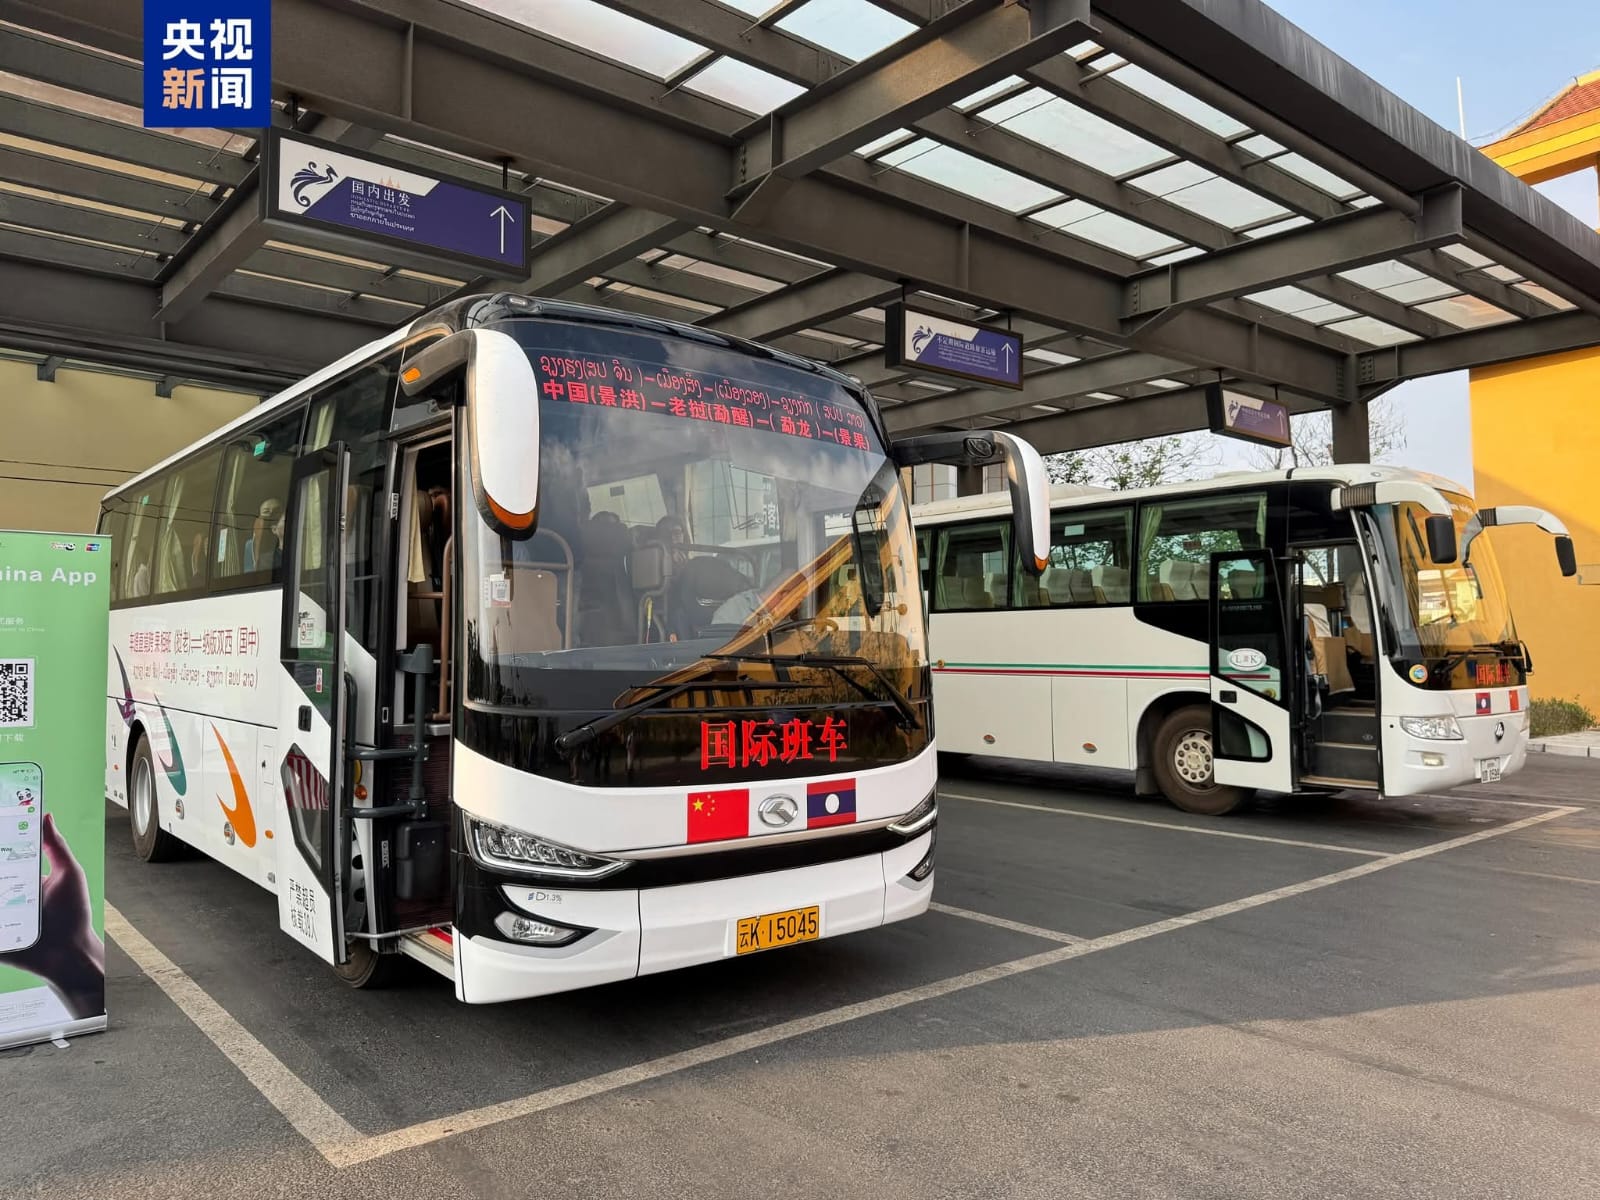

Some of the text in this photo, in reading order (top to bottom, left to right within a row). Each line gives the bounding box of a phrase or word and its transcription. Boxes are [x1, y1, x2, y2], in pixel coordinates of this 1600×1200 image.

[352, 180, 411, 208] 国内出发
[50, 567, 97, 586] App
[700, 716, 848, 770] 国际班车
